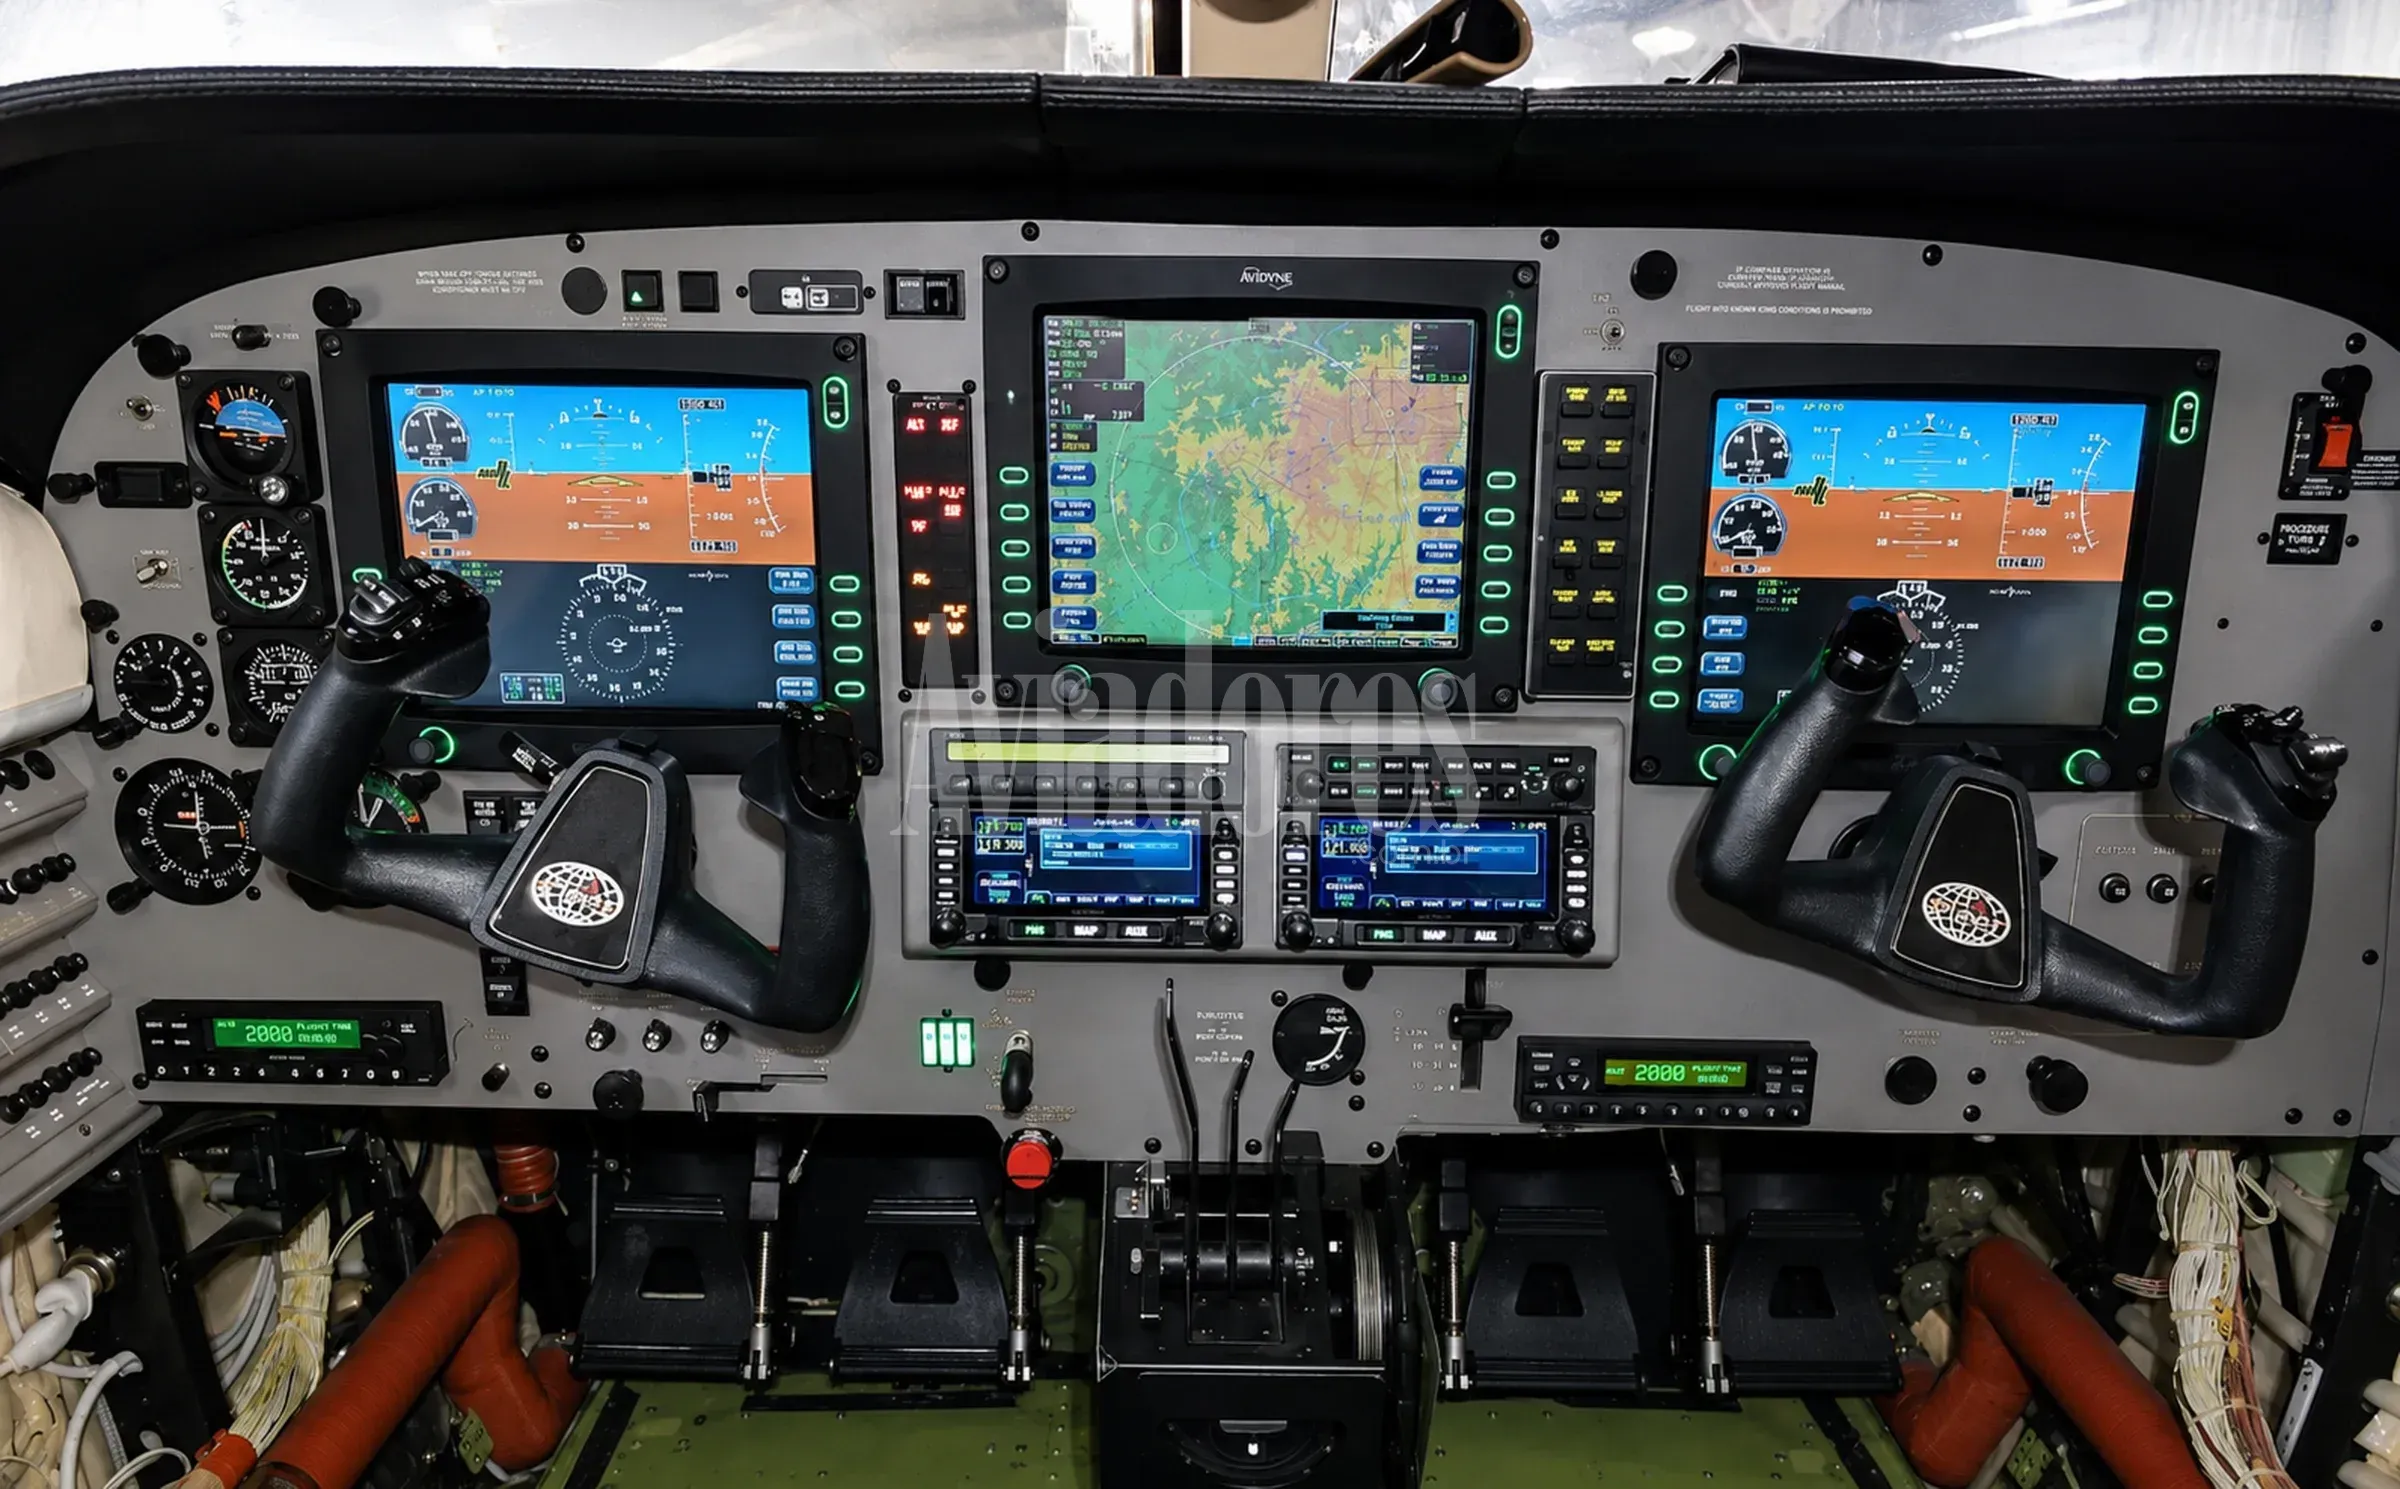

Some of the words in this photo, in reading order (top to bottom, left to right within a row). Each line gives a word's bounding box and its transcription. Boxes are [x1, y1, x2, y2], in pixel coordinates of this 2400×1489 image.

[1240, 268, 1293, 288] AVIDYNE
[245, 1024, 293, 1043] 2000
[1634, 1063, 1686, 1082] 2000
